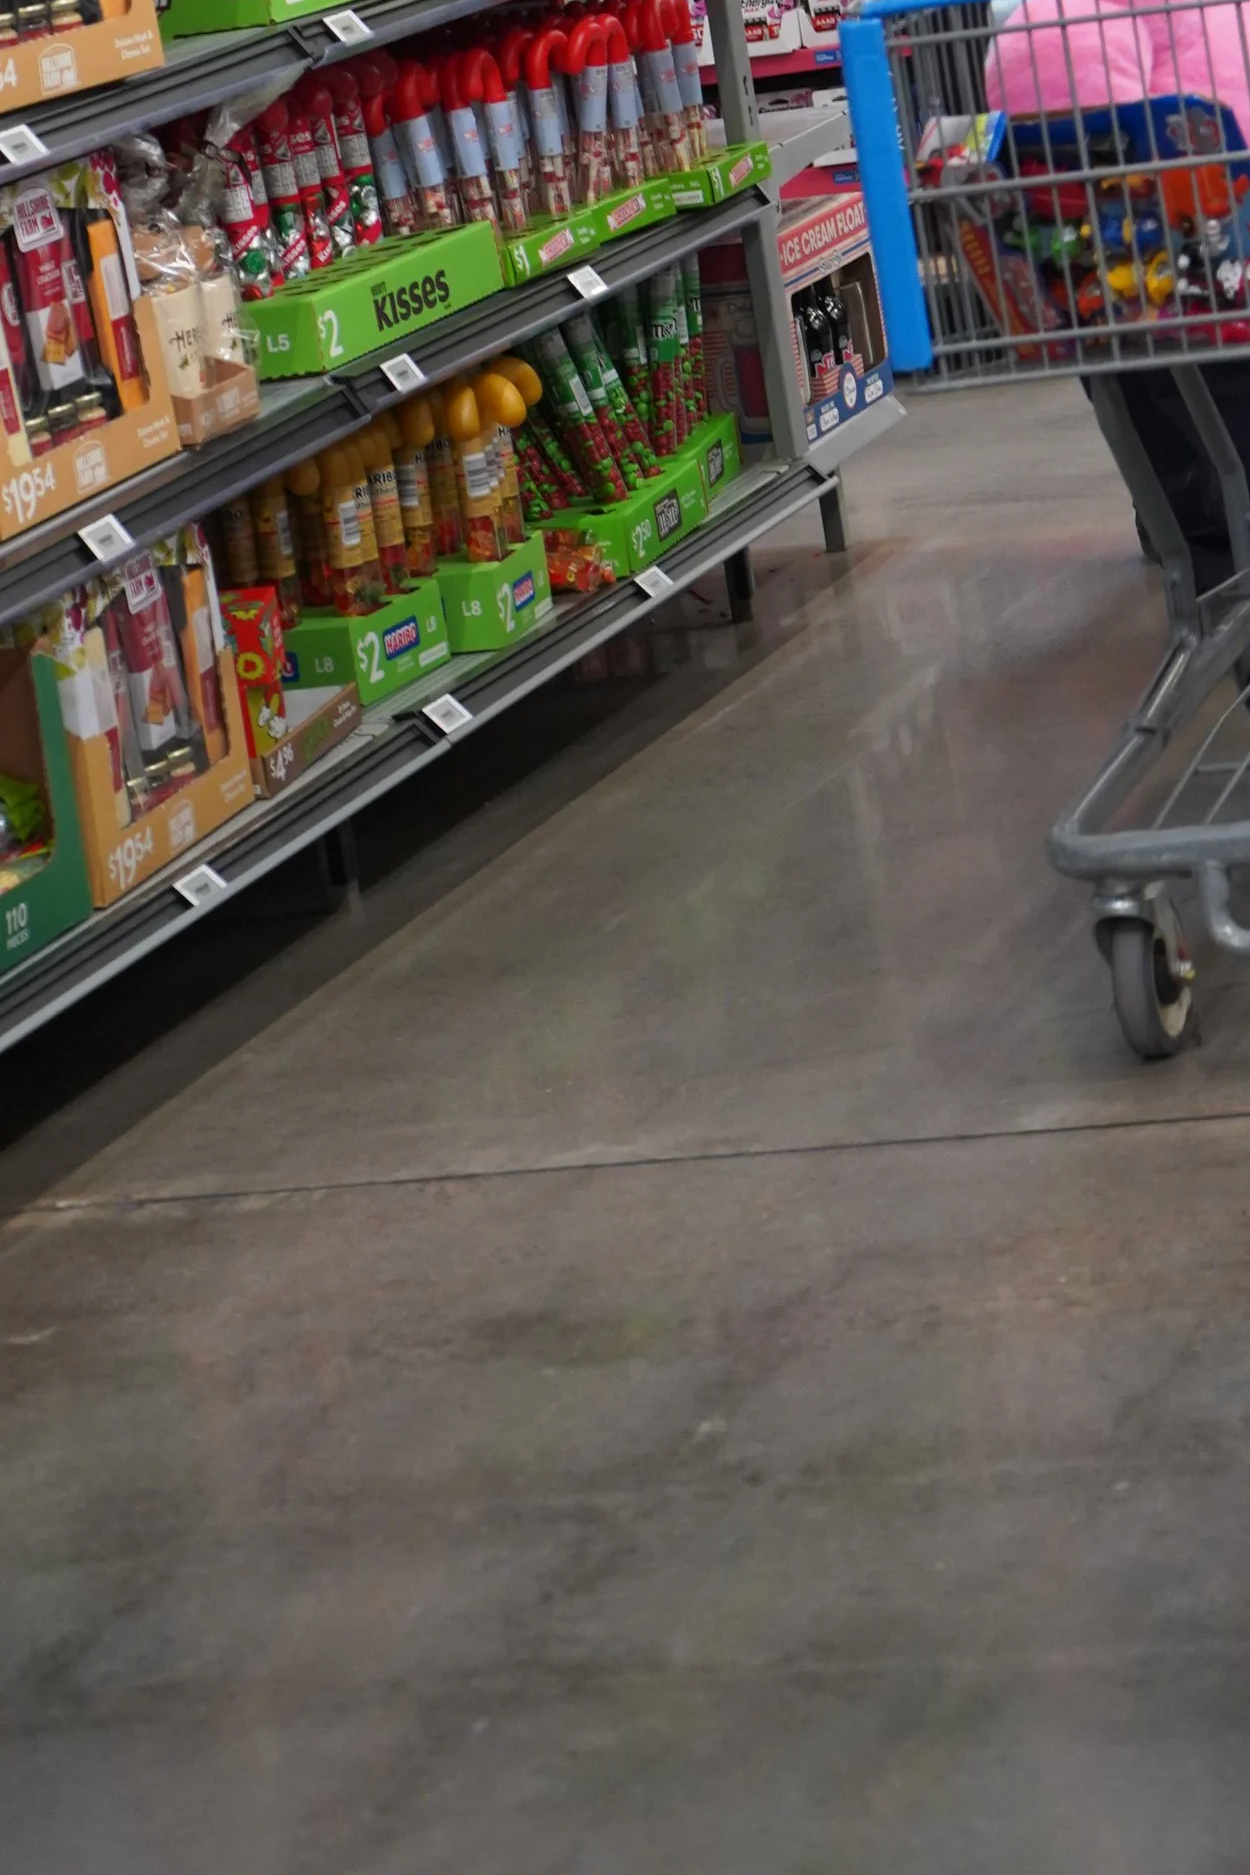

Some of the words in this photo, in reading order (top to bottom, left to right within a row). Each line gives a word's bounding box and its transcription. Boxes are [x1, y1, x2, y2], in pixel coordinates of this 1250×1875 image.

[782, 236, 802, 266] ICE
[801, 217, 837, 254] CREAM
[835, 200, 865, 236] FLOAT
[266, 334, 290, 353] L5
[318, 309, 344, 359] $2
[462, 600, 483, 618] L8
[496, 582, 516, 634] $2
[356, 630, 385, 684] $2
[383, 620, 419, 655] HARIBO
[314, 656, 335, 673] L8
